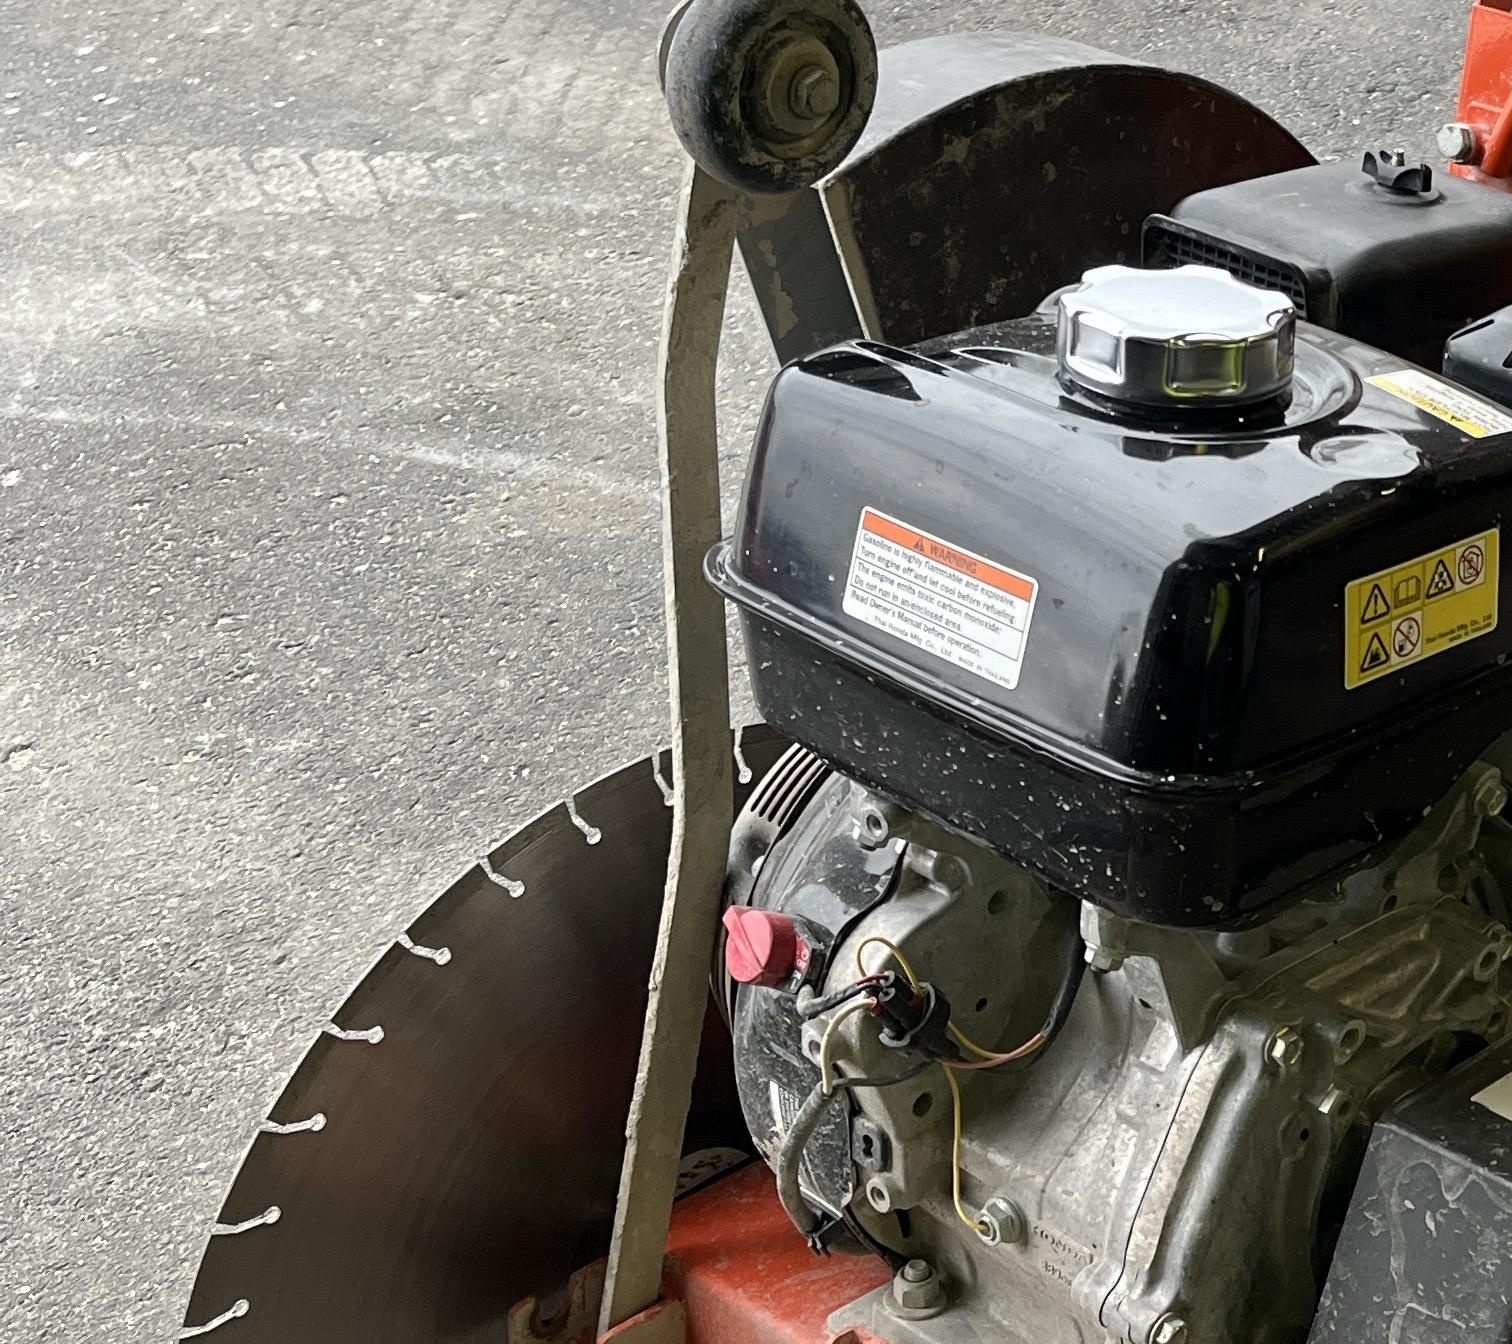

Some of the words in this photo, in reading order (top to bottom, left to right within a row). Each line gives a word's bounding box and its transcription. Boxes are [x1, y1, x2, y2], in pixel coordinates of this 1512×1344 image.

[860, 546, 876, 559] Turn
[877, 556, 900, 572] engine
[914, 571, 926, 582] and
[940, 582, 955, 595] cool
[958, 590, 980, 606] before
[863, 534, 891, 552] Gasoline
[902, 551, 922, 567] highly
[925, 561, 963, 584] flammable
[965, 579, 978, 591] and
[929, 544, 977, 574] WARNING
[851, 590, 868, 604] Read
[870, 599, 895, 617] Owner's
[897, 612, 921, 629] Manual
[923, 624, 945, 640] before
[858, 563, 869, 574] The
[871, 571, 894, 586] engine
[897, 581, 915, 595] emits
[918, 591, 934, 603] toxic
[937, 599, 962, 616] carbon
[910, 601, 942, 622] enclosed
